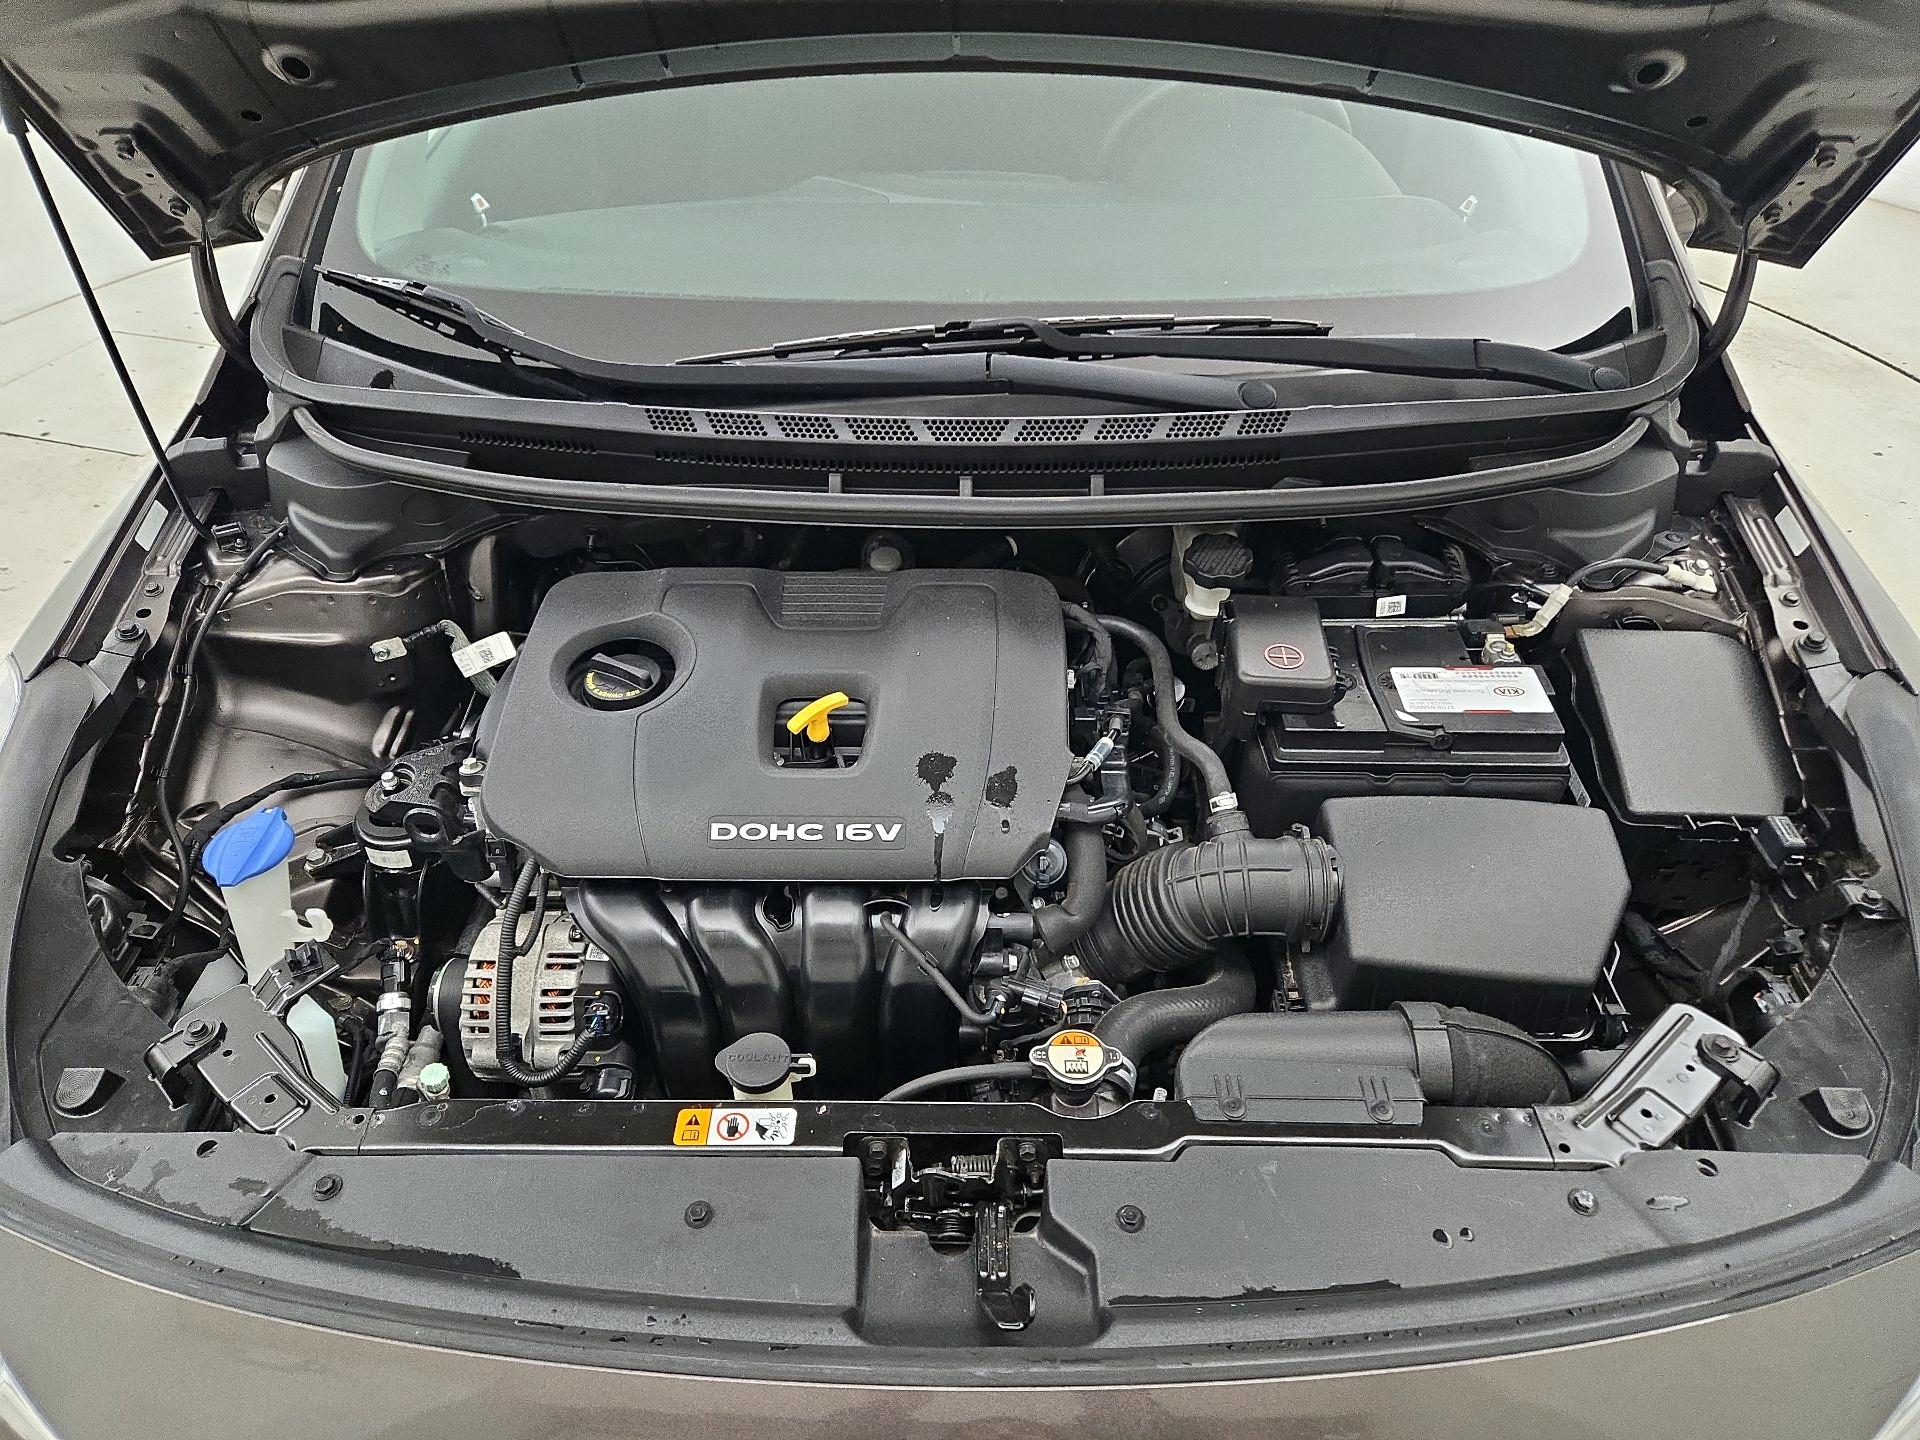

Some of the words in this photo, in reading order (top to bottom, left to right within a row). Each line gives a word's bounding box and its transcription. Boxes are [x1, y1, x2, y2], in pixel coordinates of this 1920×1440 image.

[710, 823, 824, 841] DOHC
[835, 823, 902, 842] 16V
[729, 1053, 790, 1063] COOLANT
[1109, 1051, 1120, 1060] 1.1
